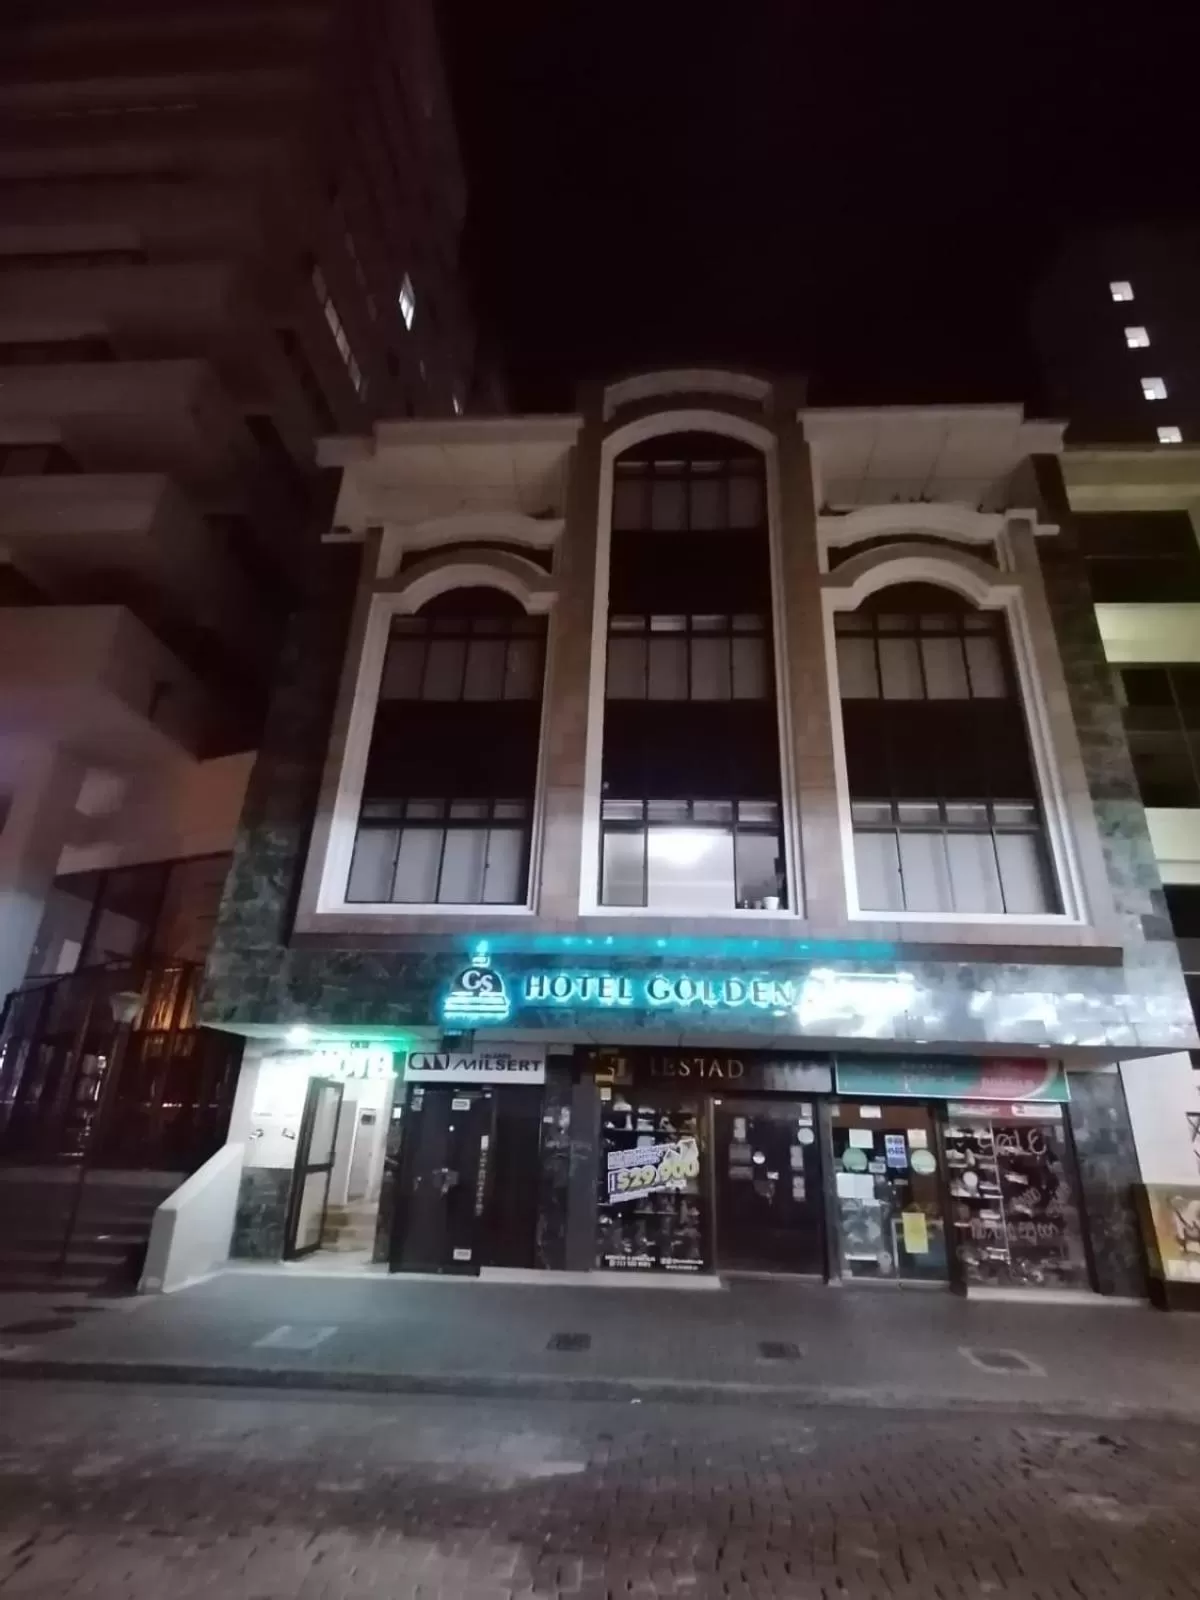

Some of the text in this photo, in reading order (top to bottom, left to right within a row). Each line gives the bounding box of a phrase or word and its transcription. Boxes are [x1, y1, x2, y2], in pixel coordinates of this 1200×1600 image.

[525, 975, 793, 1001] HOTEL GOLDEN
[452, 1058, 541, 1072] MILSERT
